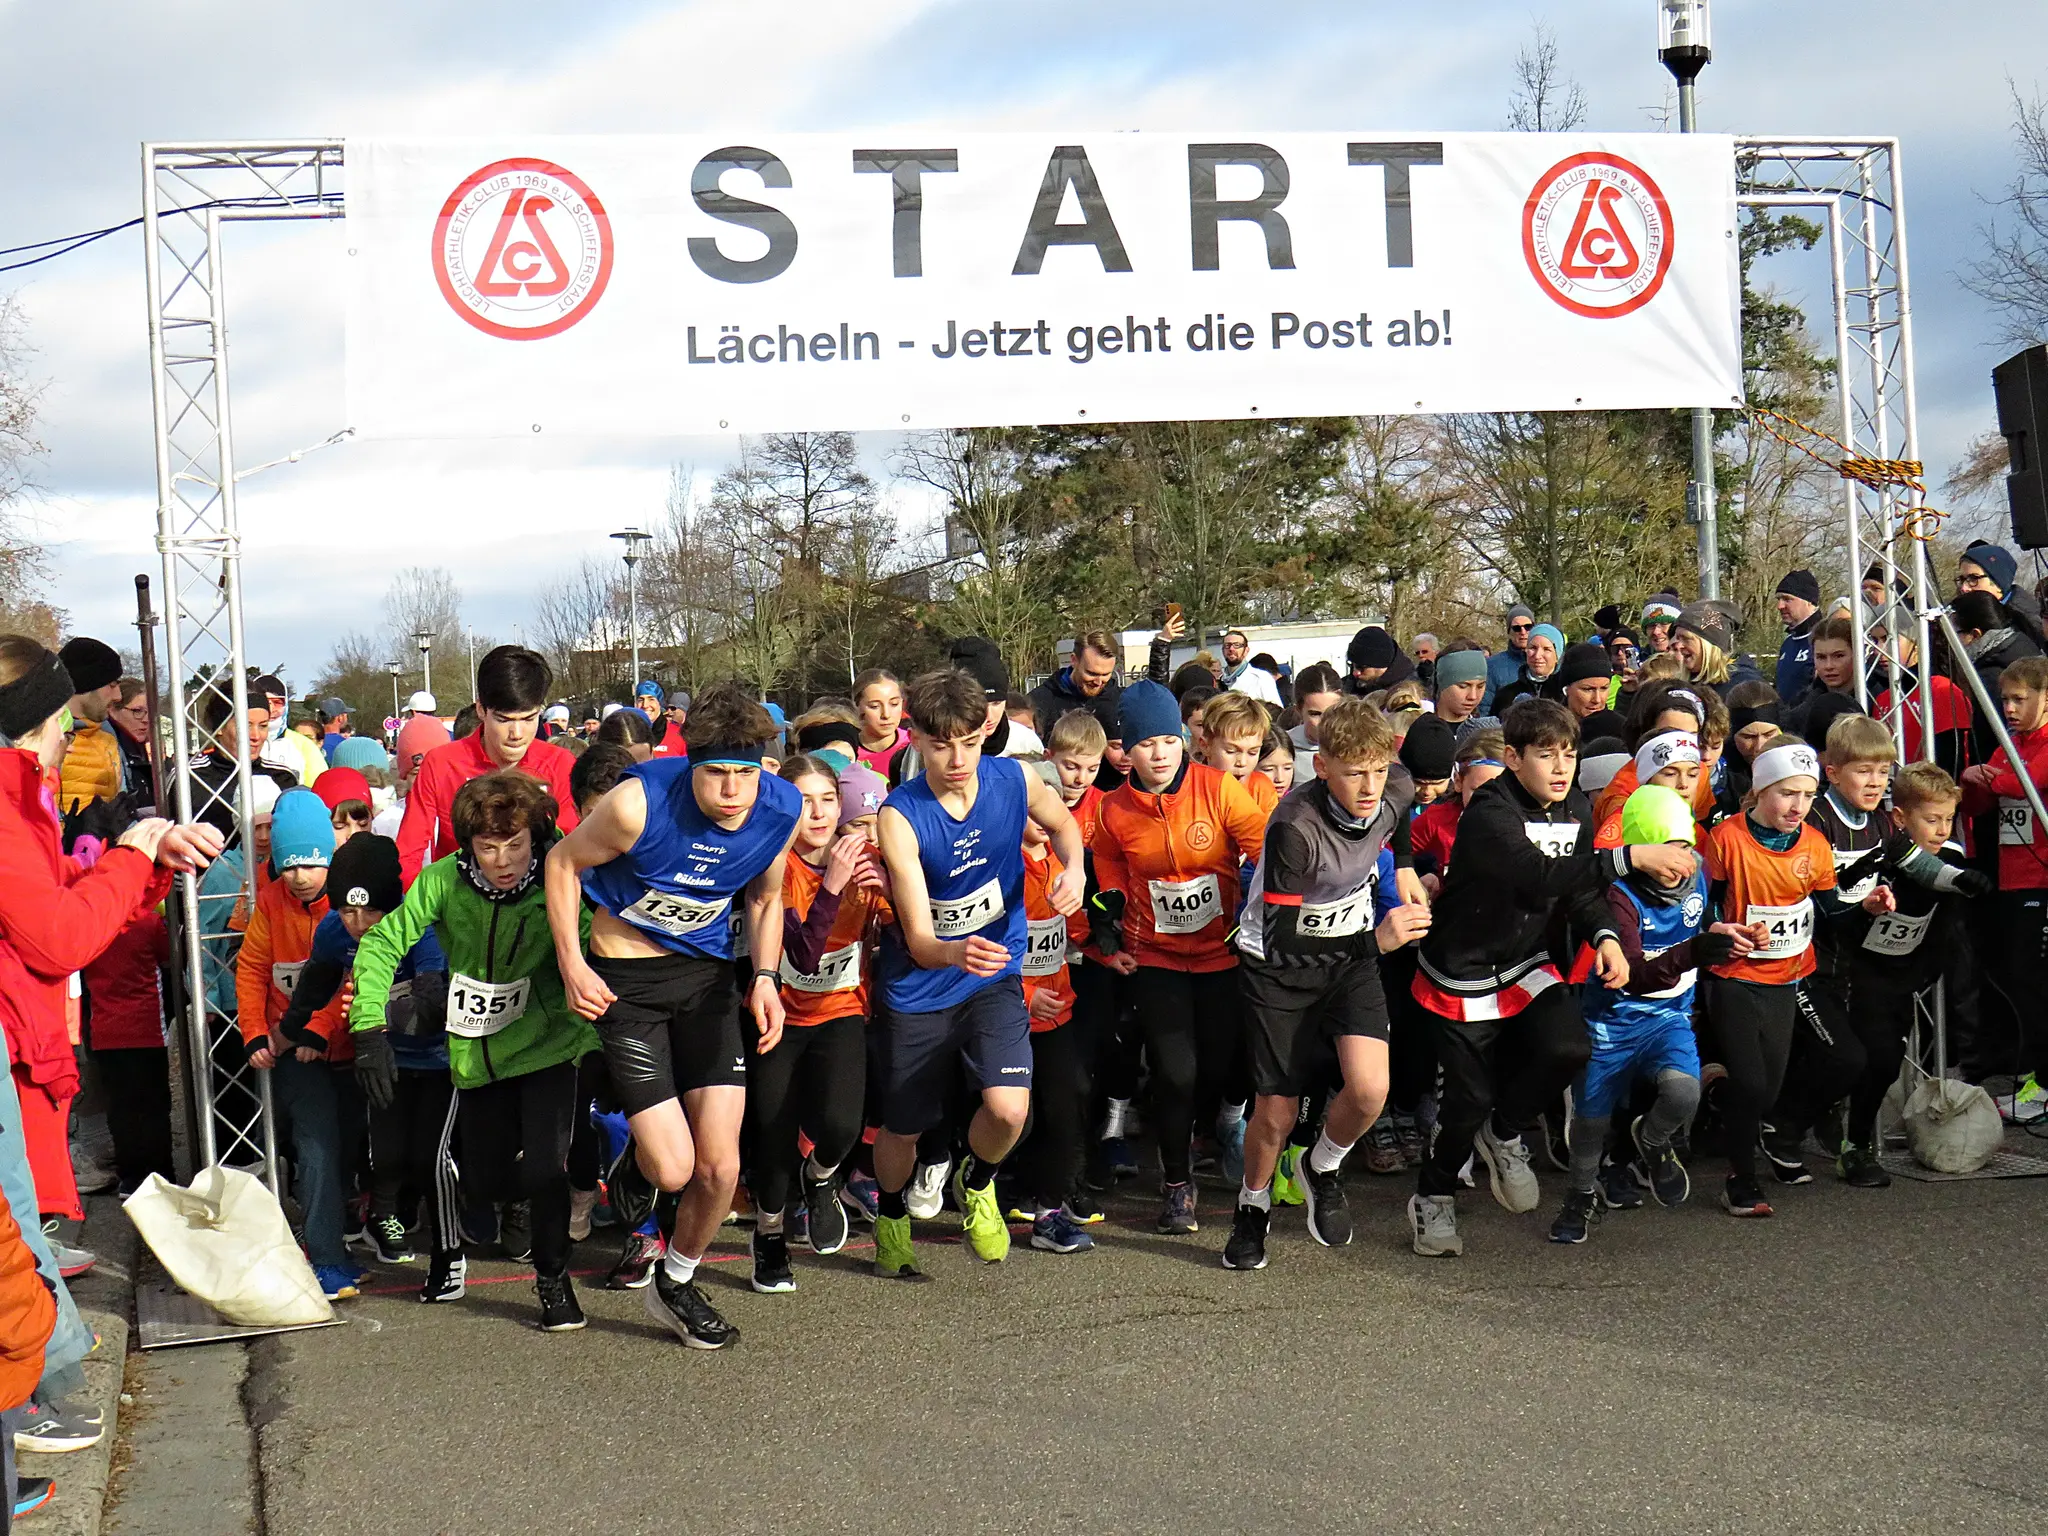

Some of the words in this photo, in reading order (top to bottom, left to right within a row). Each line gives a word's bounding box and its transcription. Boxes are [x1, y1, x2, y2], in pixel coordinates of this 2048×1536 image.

[688, 142, 1443, 283] START
[516, 174, 549, 190] 1969
[559, 203, 597, 313] SCHIFFERSTADT
[1591, 167, 1618, 181] 1969
[1629, 195, 1660, 295] SCHIFFERSTADT
[688, 322, 880, 364] Lächeln
[931, 319, 1052, 359] Jetzt
[1067, 316, 1171, 363] geht
[1186, 313, 1255, 352] die
[1272, 312, 1373, 350] Post
[1387, 309, 1453, 348] ab!
[350, 890, 367, 902] BVB
[1157, 886, 1213, 913] 1406
[645, 900, 717, 923] 1330
[930, 898, 991, 922] 1371
[1302, 904, 1356, 928] 617
[1027, 931, 1065, 953] 1404
[454, 989, 522, 1015] 1351
